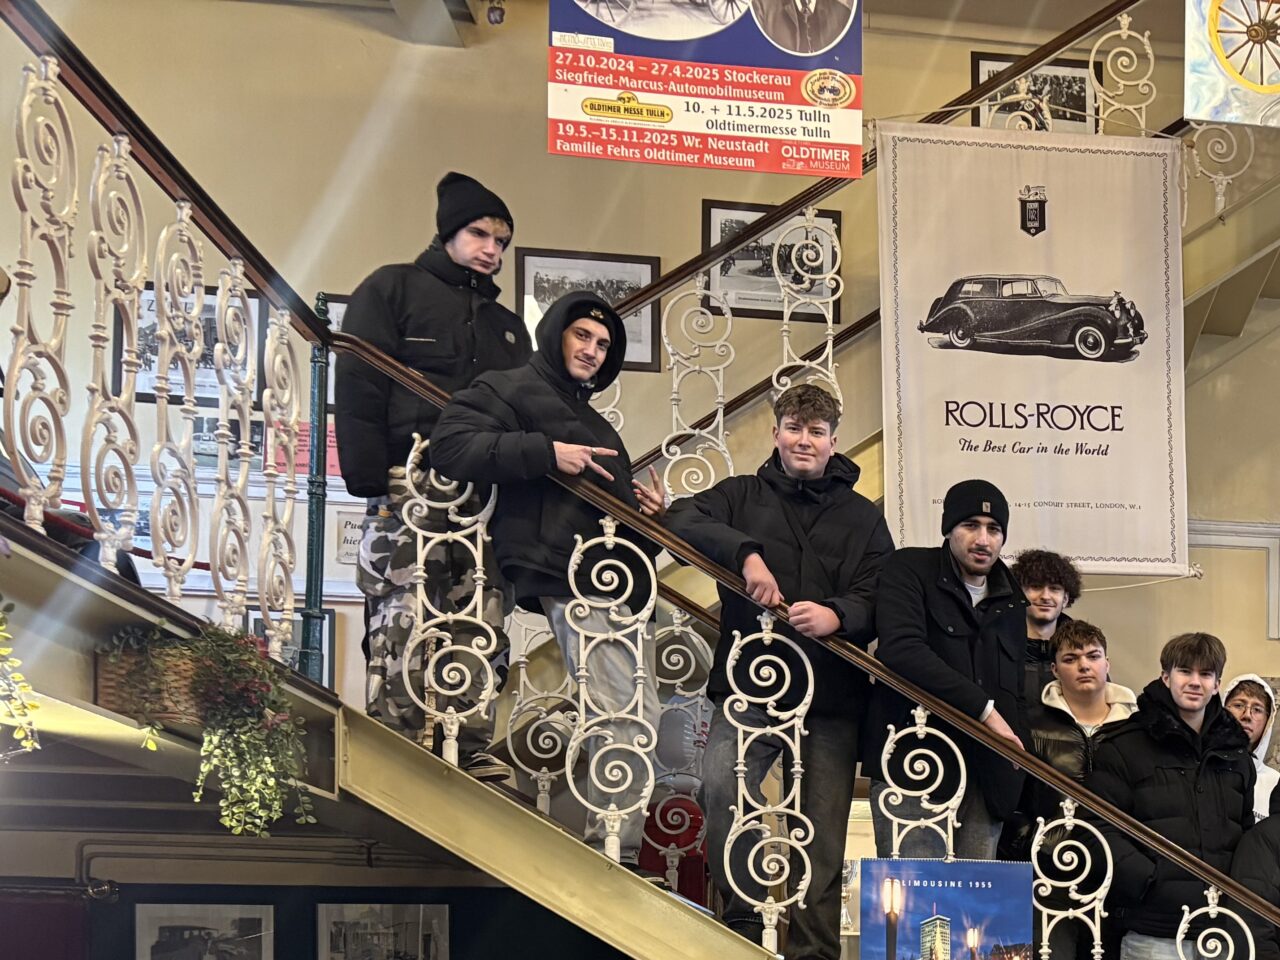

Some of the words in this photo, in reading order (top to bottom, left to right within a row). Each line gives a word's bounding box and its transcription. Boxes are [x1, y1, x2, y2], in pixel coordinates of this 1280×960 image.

[555, 51, 635, 72] 27.10.2024
[650, 62, 720, 80] 27.4.2025
[724, 69, 792, 86] Stockerau
[555, 69, 785, 102] Siegfried-Marcus-Automobilmuseum
[589, 102, 622, 113] OLDTIMER
[623, 107, 644, 116] MESSE
[645, 109, 665, 118] TULLN
[684, 101, 705, 114] 10.
[726, 104, 793, 120] 11.5.2025
[797, 109, 831, 123] Tulln
[557, 122, 678, 146] 19.5.–15.11.2025
[682, 135, 703, 148] Wr.
[707, 137, 770, 154] Neustadt
[705, 119, 797, 136] Oldtimermesse
[800, 126, 831, 139] Tulln
[556, 140, 604, 155] Familie
[606, 144, 641, 159] Fehrs
[644, 148, 700, 163] Oldtimer
[703, 153, 756, 168] Museum
[781, 145, 850, 162] OLDTIMER
[809, 160, 850, 171] MUSEUM
[944, 400, 1125, 432] ROLLS-ROYCE
[958, 437, 980, 453] The
[982, 439, 1007, 453] Best
[1011, 441, 1034, 454] Car
[1036, 442, 1049, 454] in
[1053, 443, 1071, 456] the
[1074, 442, 1110, 457] World
[1033, 501, 1064, 509] CONDUIT
[1066, 502, 1093, 510] STREET,
[1095, 502, 1128, 511] LONDON,
[901, 879, 963, 889] LIMOUSINE
[969, 881, 993, 889] 1955
